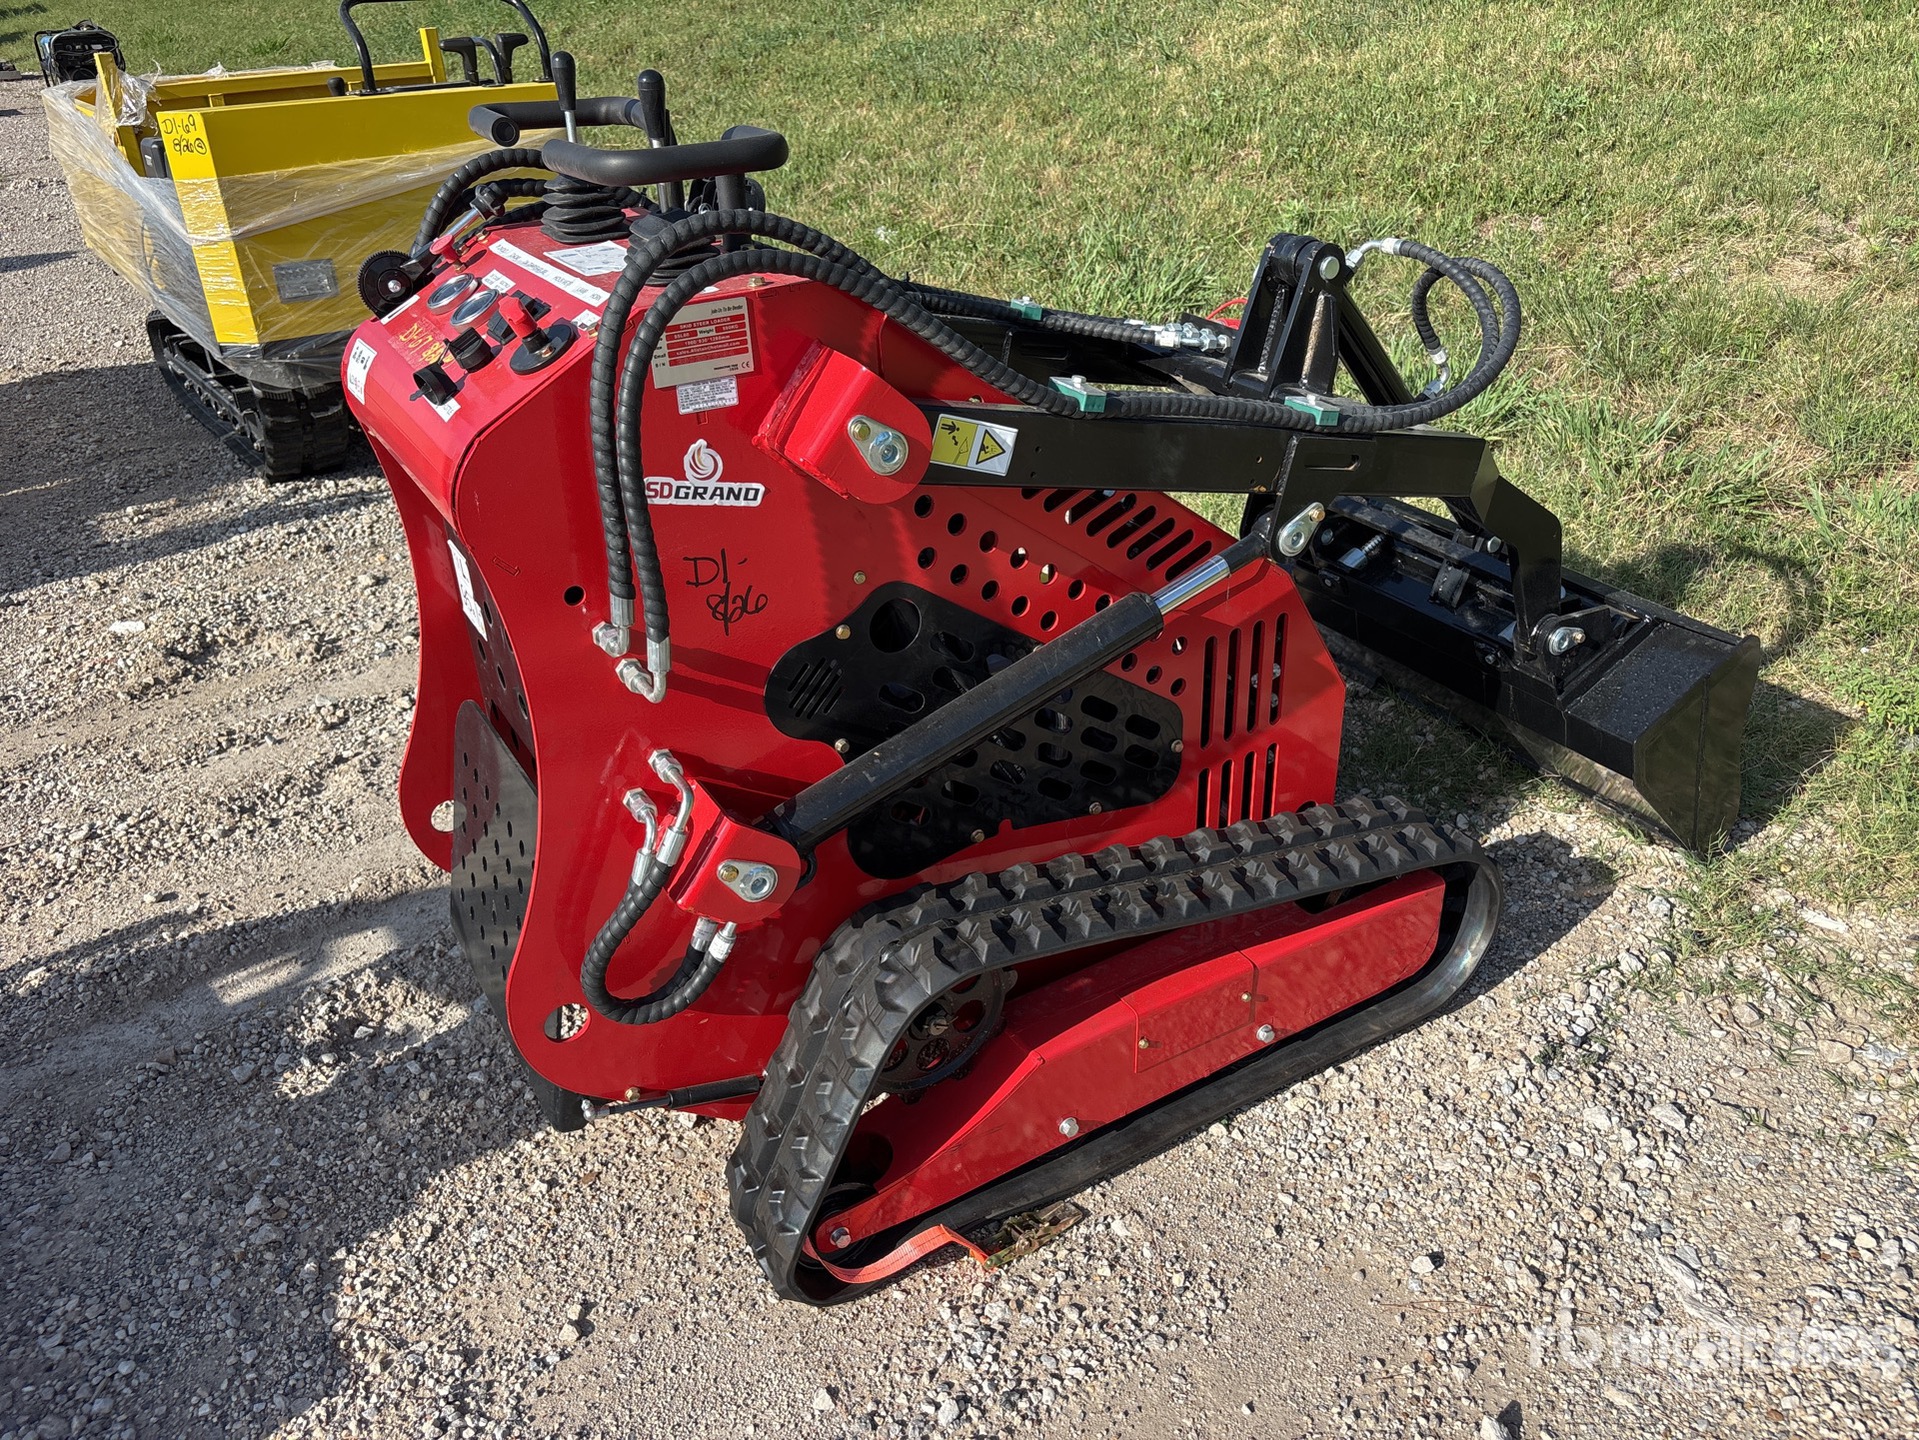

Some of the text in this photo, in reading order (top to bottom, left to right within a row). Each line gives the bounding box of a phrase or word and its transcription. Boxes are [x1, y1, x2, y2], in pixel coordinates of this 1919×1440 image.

[693, 320, 710, 328] STEER
[710, 317, 731, 325] LOADER
[646, 481, 761, 501] SDGRAND
